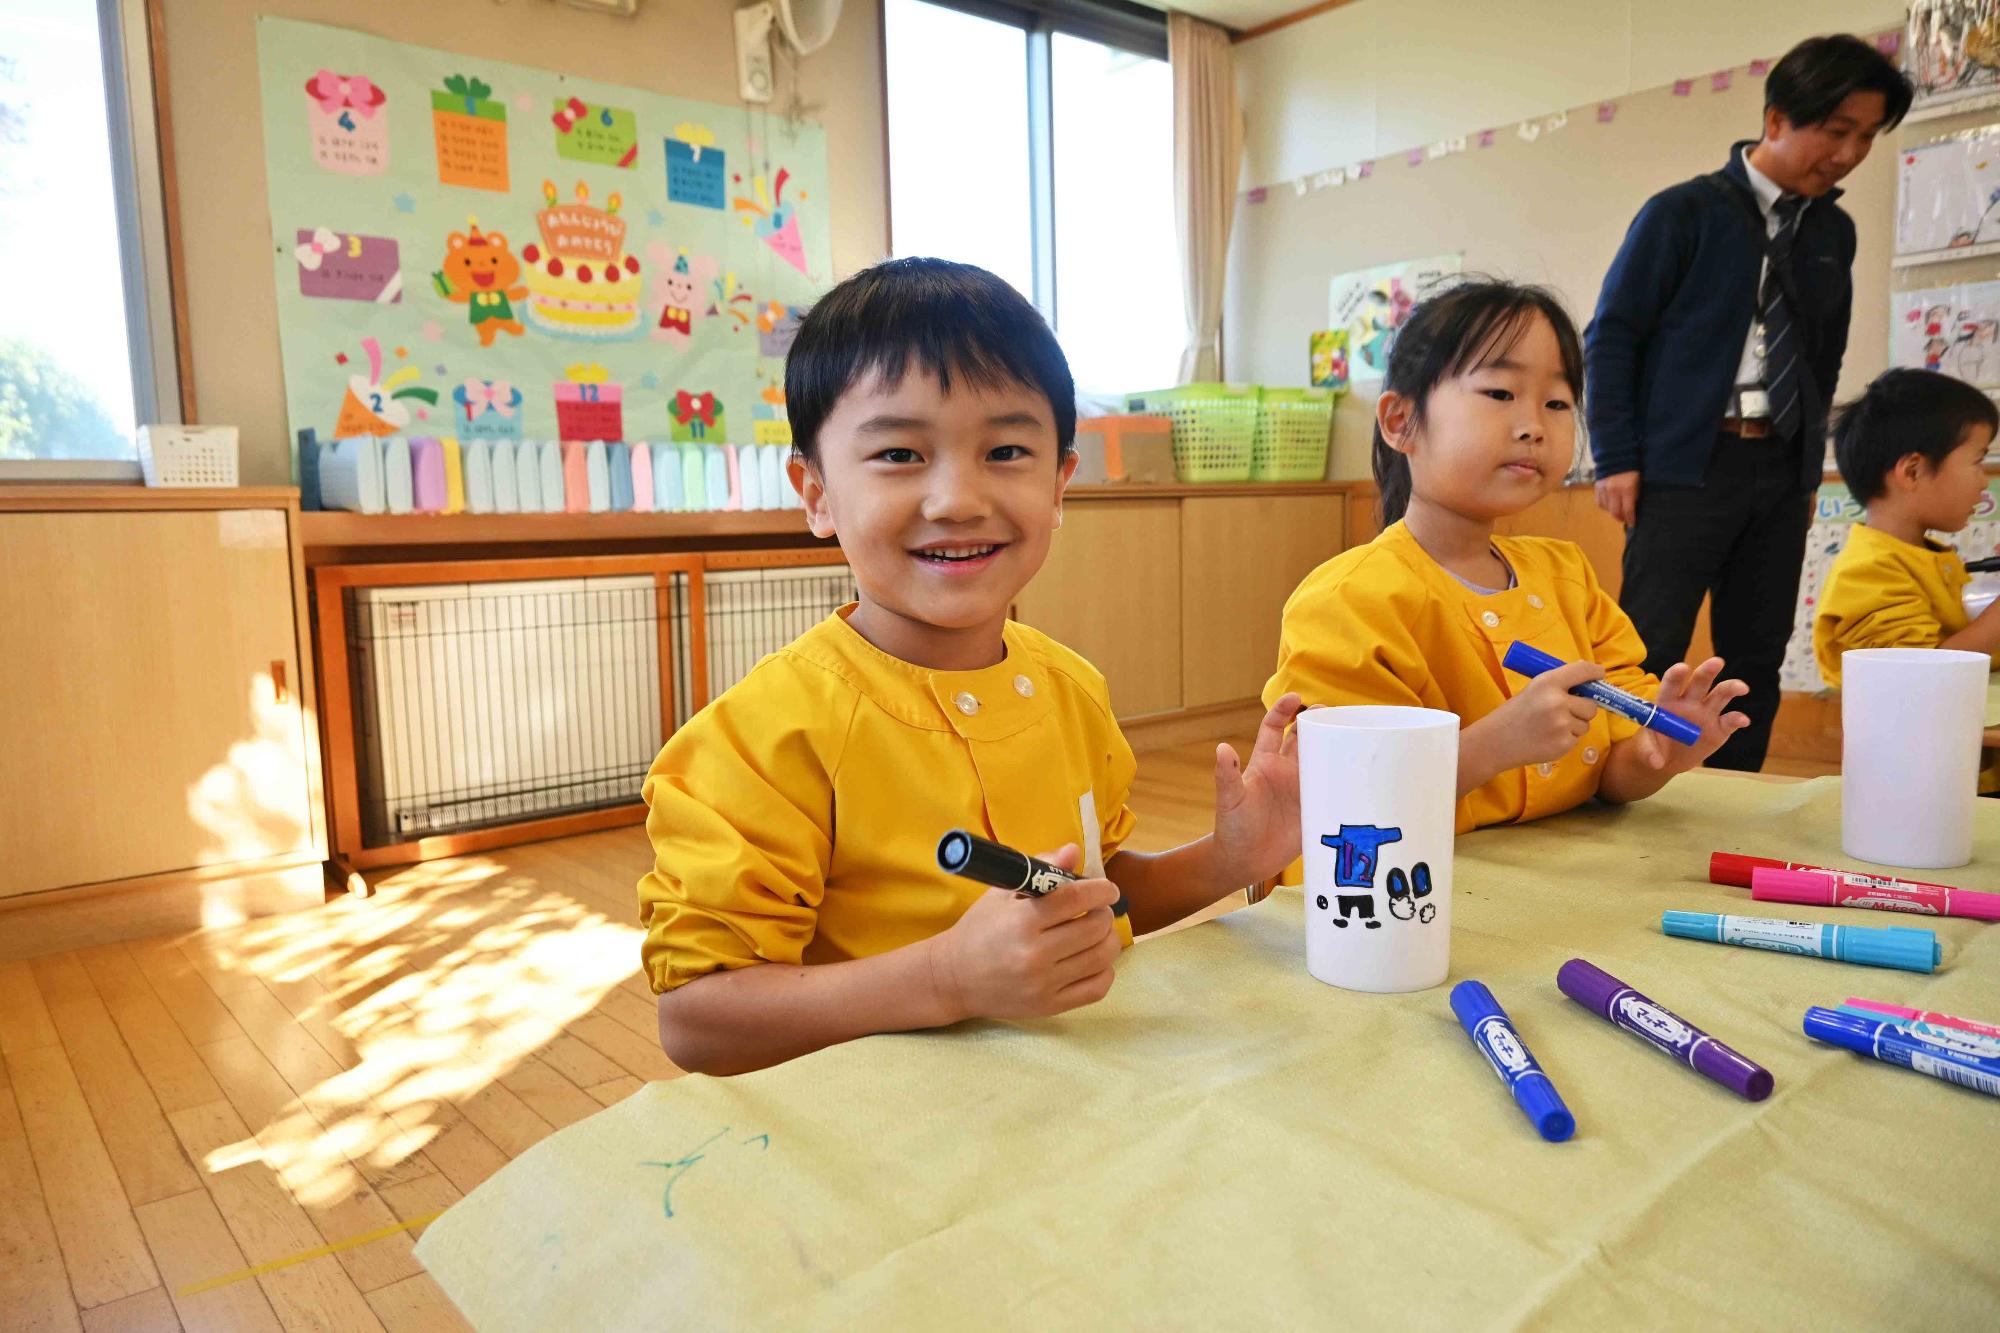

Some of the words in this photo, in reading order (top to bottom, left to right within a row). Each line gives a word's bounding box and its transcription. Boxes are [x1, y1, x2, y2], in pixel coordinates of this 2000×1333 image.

[347, 235, 362, 258] 3
[369, 392, 384, 413] 2
[580, 383, 600, 402] 12
[1636, 1007, 1671, 1034] マッキー
[1493, 1032, 1514, 1059] マッキー
